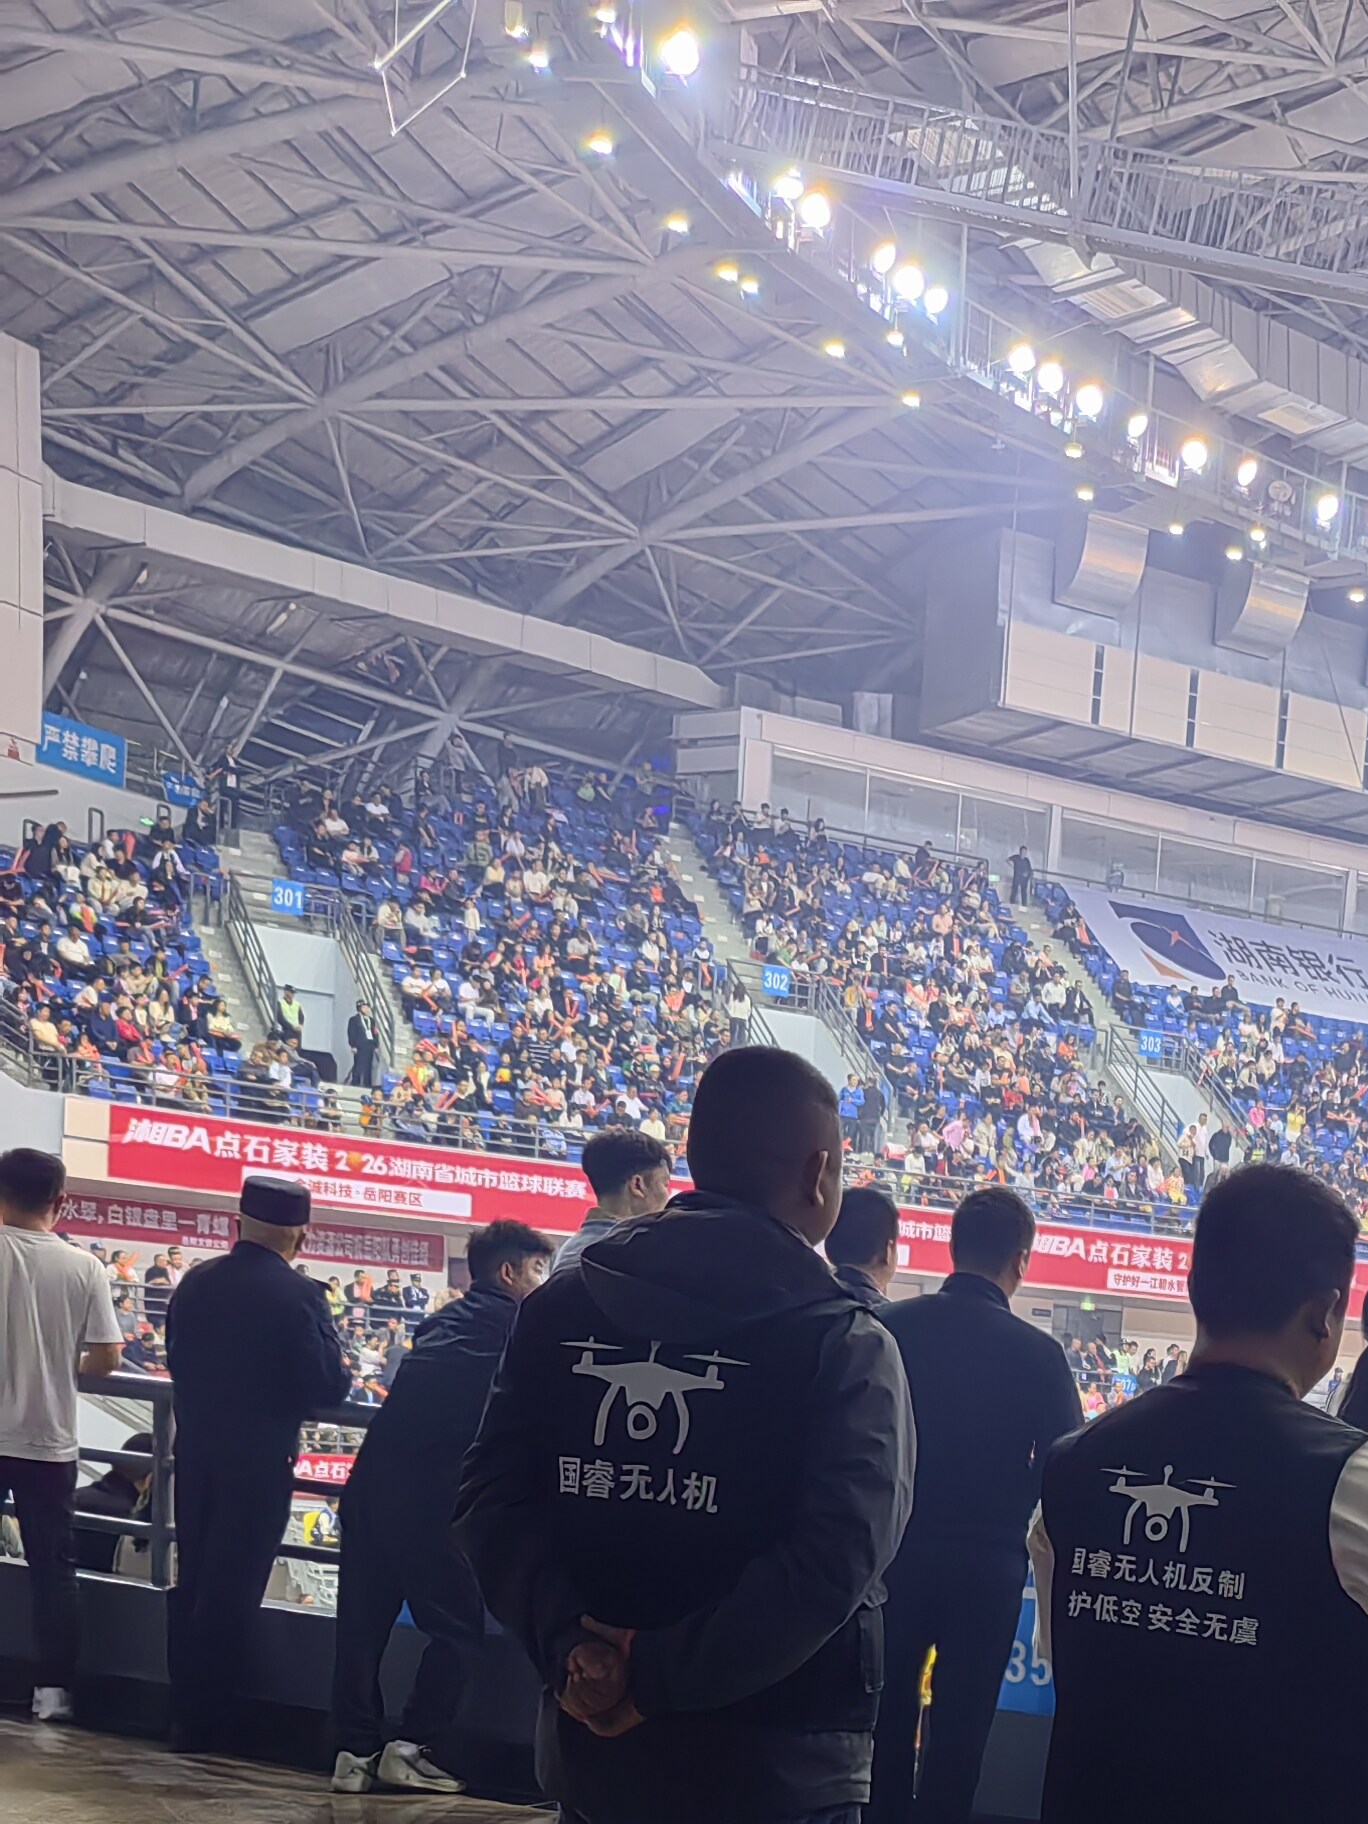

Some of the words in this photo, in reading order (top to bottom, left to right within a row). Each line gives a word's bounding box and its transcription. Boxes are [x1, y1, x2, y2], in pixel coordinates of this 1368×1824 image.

[42, 723, 117, 775] 严禁攀爬
[274, 886, 303, 909] 301
[764, 971, 789, 993] 302
[1236, 969, 1289, 990] BANK
[1294, 980, 1319, 994] OF
[1141, 1035, 1161, 1053] 303
[214, 1131, 329, 1172] 点石家装
[1088, 1240, 1174, 1271] 点石家装
[558, 1456, 718, 1514] 国睿无人机
